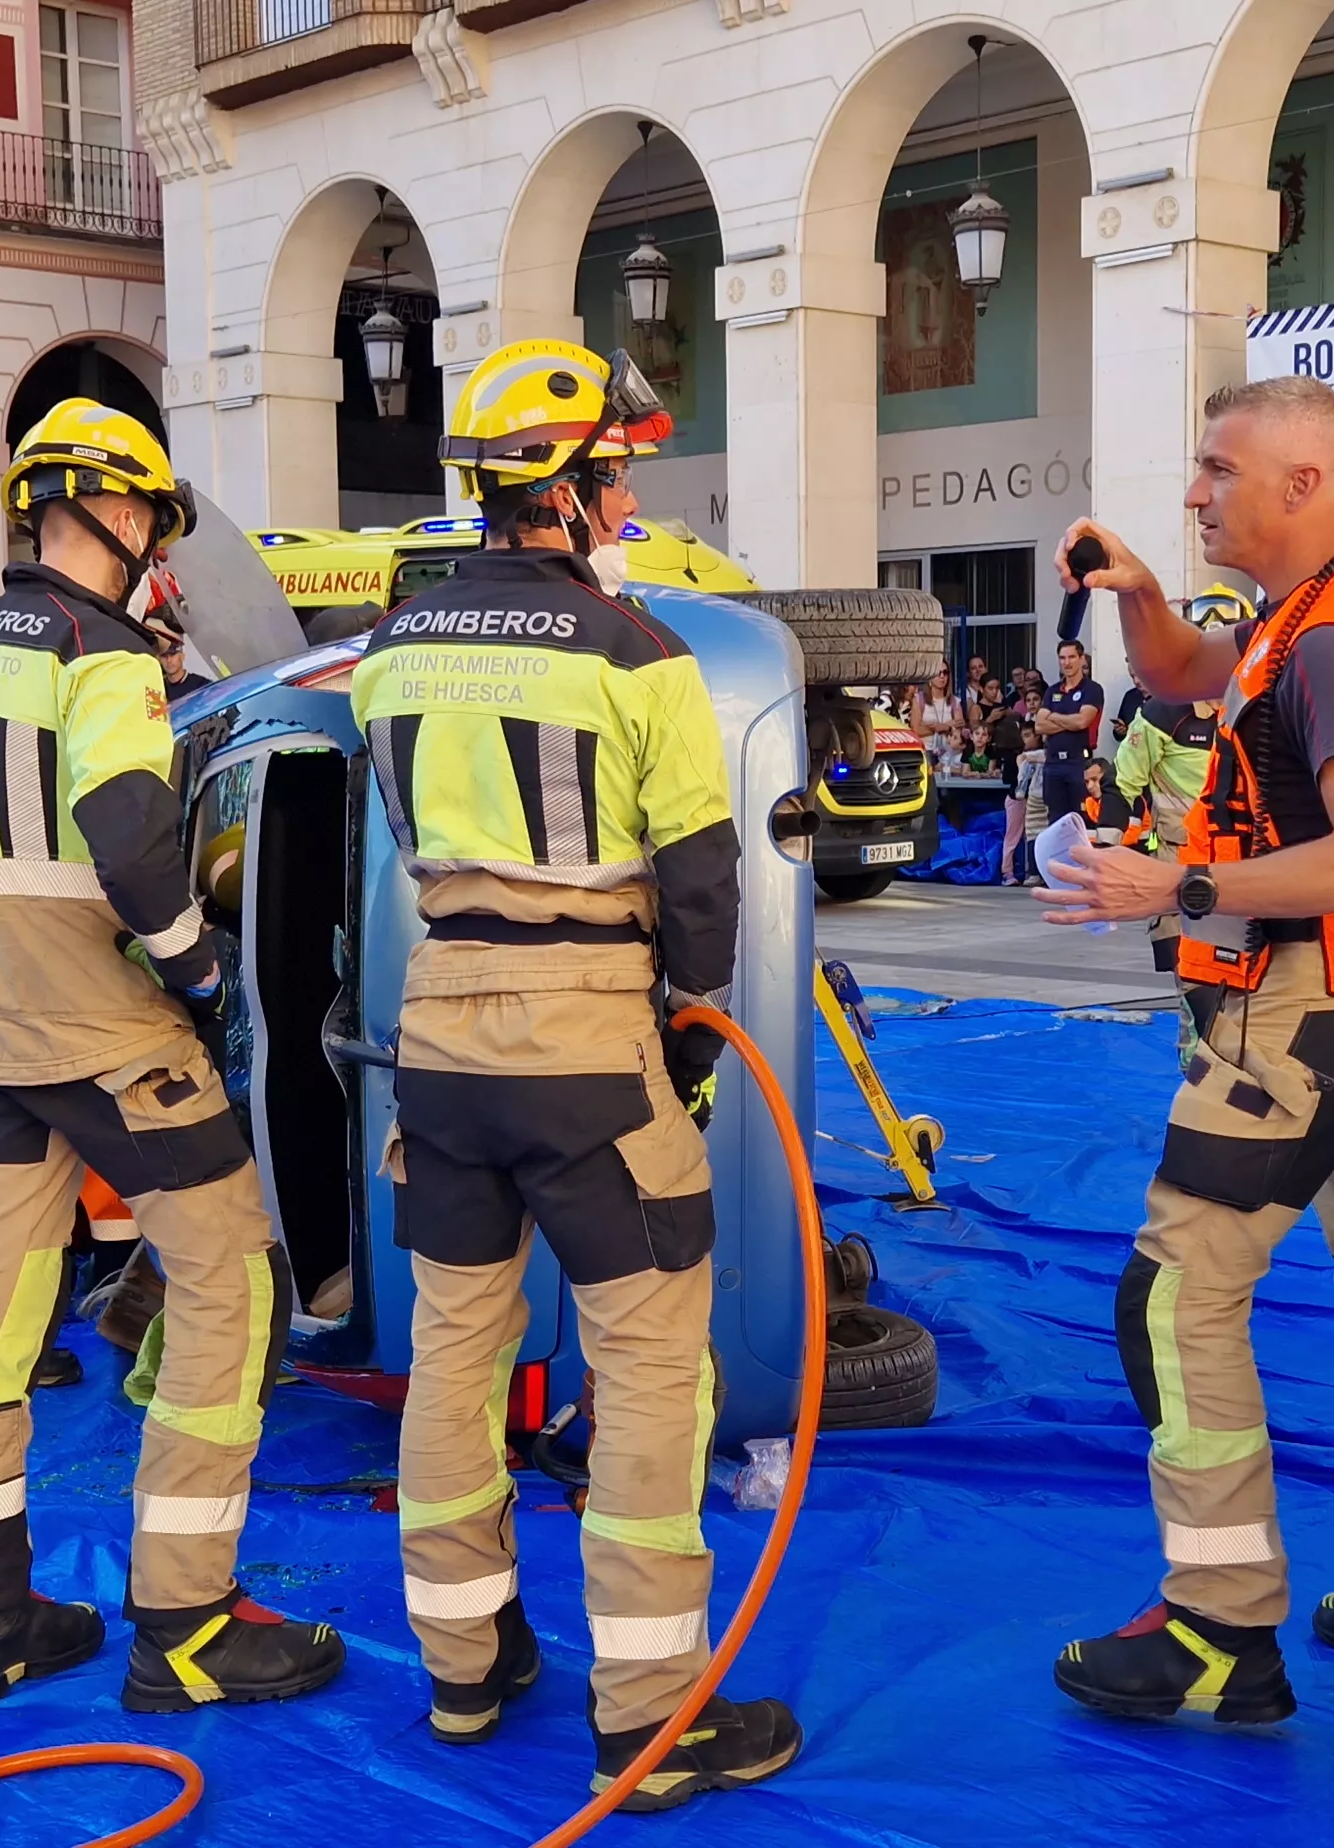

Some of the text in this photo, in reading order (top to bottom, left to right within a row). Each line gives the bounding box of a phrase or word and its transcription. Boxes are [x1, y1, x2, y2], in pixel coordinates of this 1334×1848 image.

[390, 610, 578, 638] BOMBEROS
[388, 653, 550, 676] AYUNTAMIENTO
[401, 680, 524, 704] DE HUESCA
[869, 844, 912, 861] 9731 MGZ
